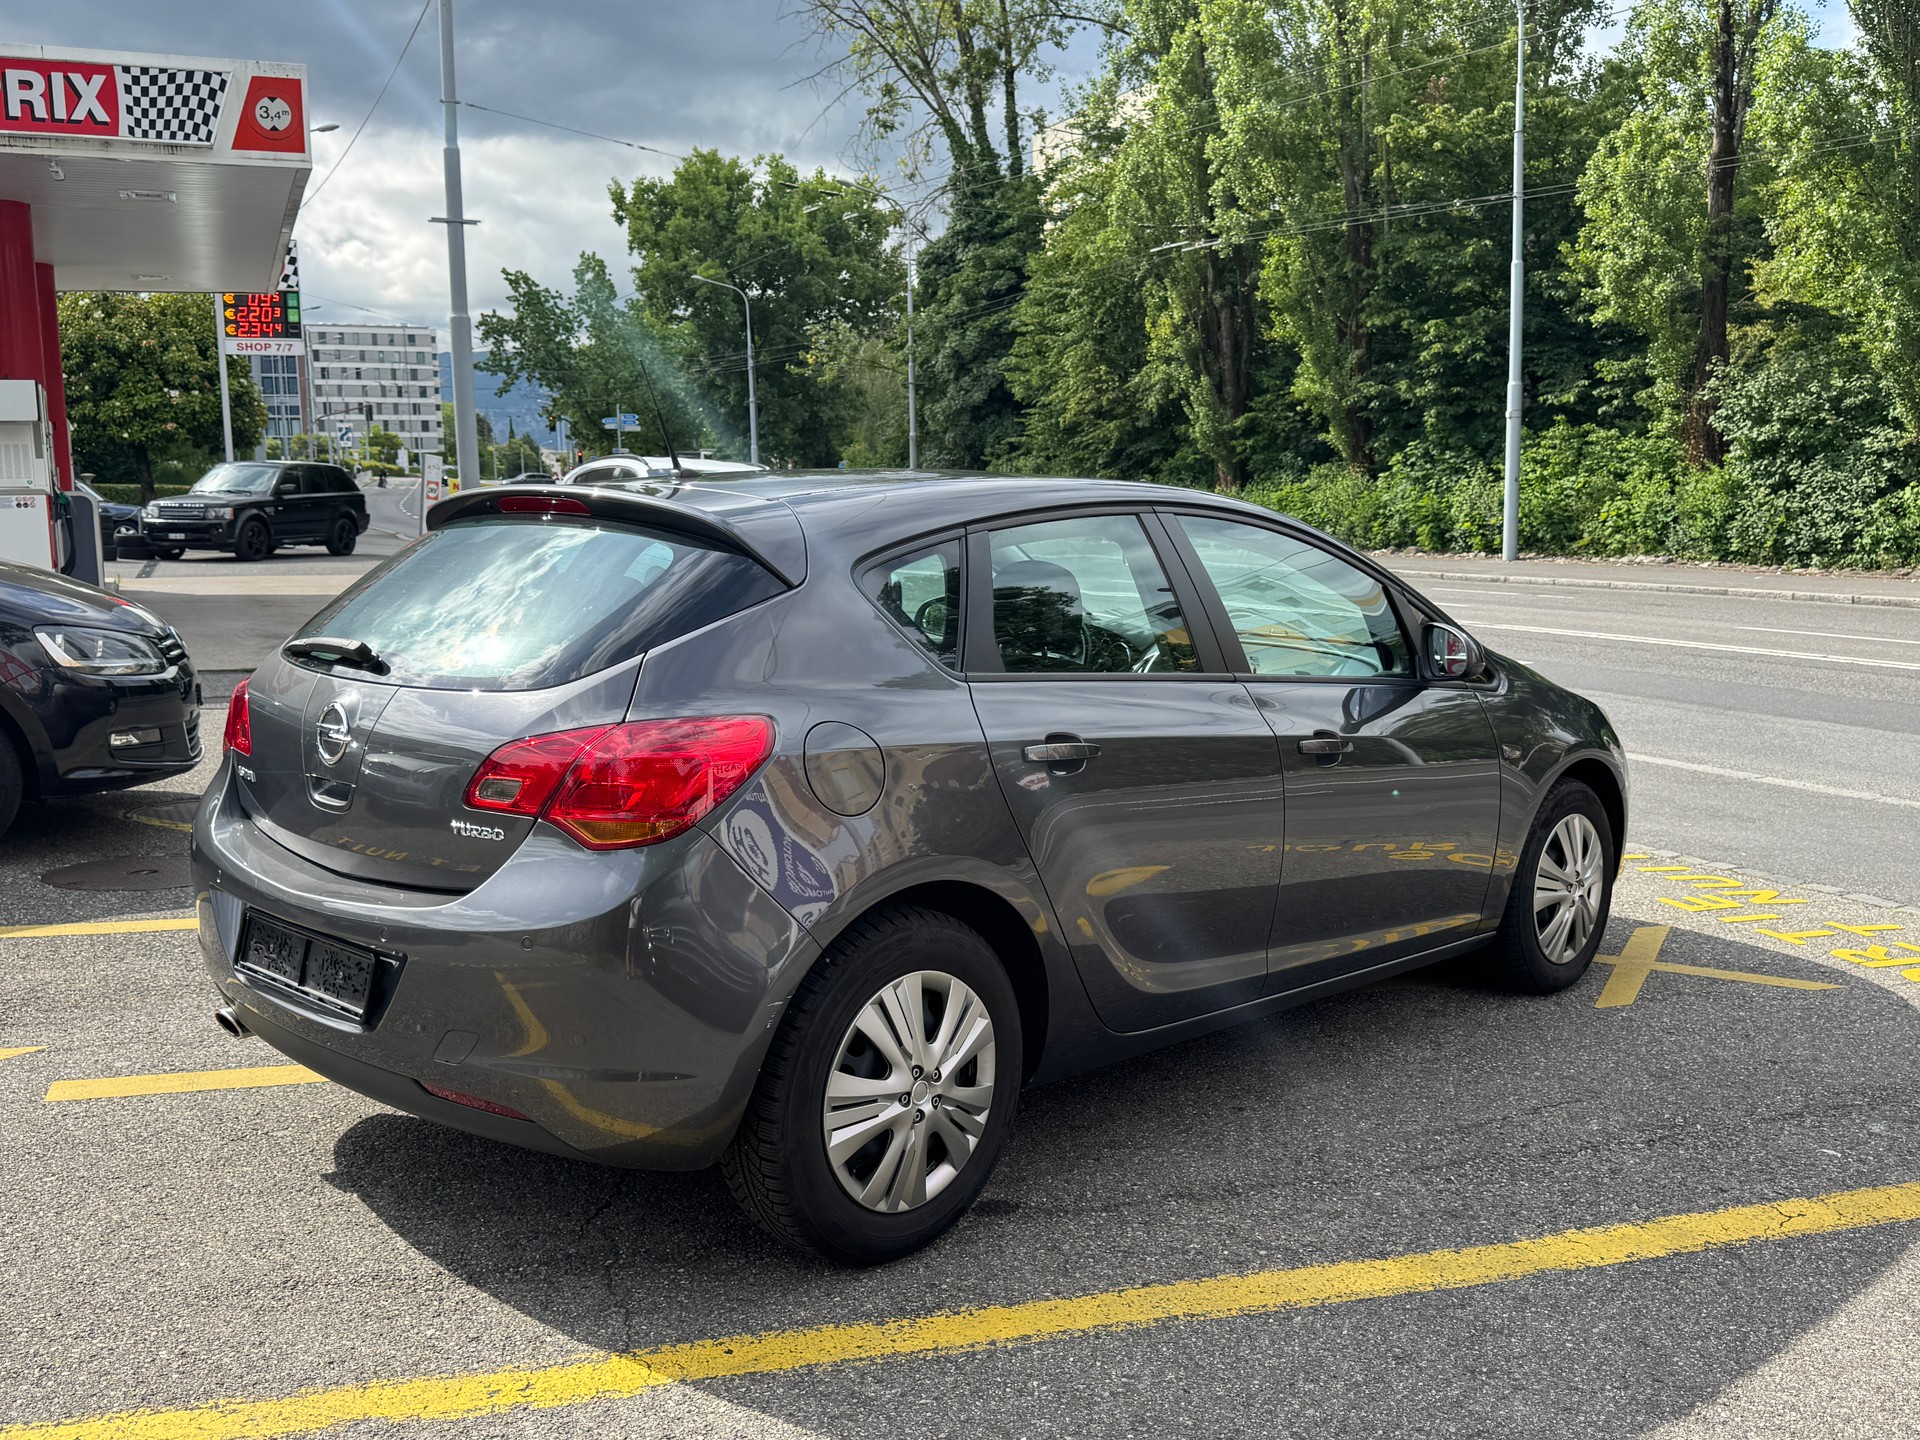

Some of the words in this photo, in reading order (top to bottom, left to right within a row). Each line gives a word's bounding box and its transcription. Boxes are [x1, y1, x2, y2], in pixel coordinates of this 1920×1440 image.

[0, 68, 111, 124] RIX
[236, 342, 272, 352] SHOP
[275, 343, 293, 353] 7/7
[450, 819, 505, 841] TURBO
